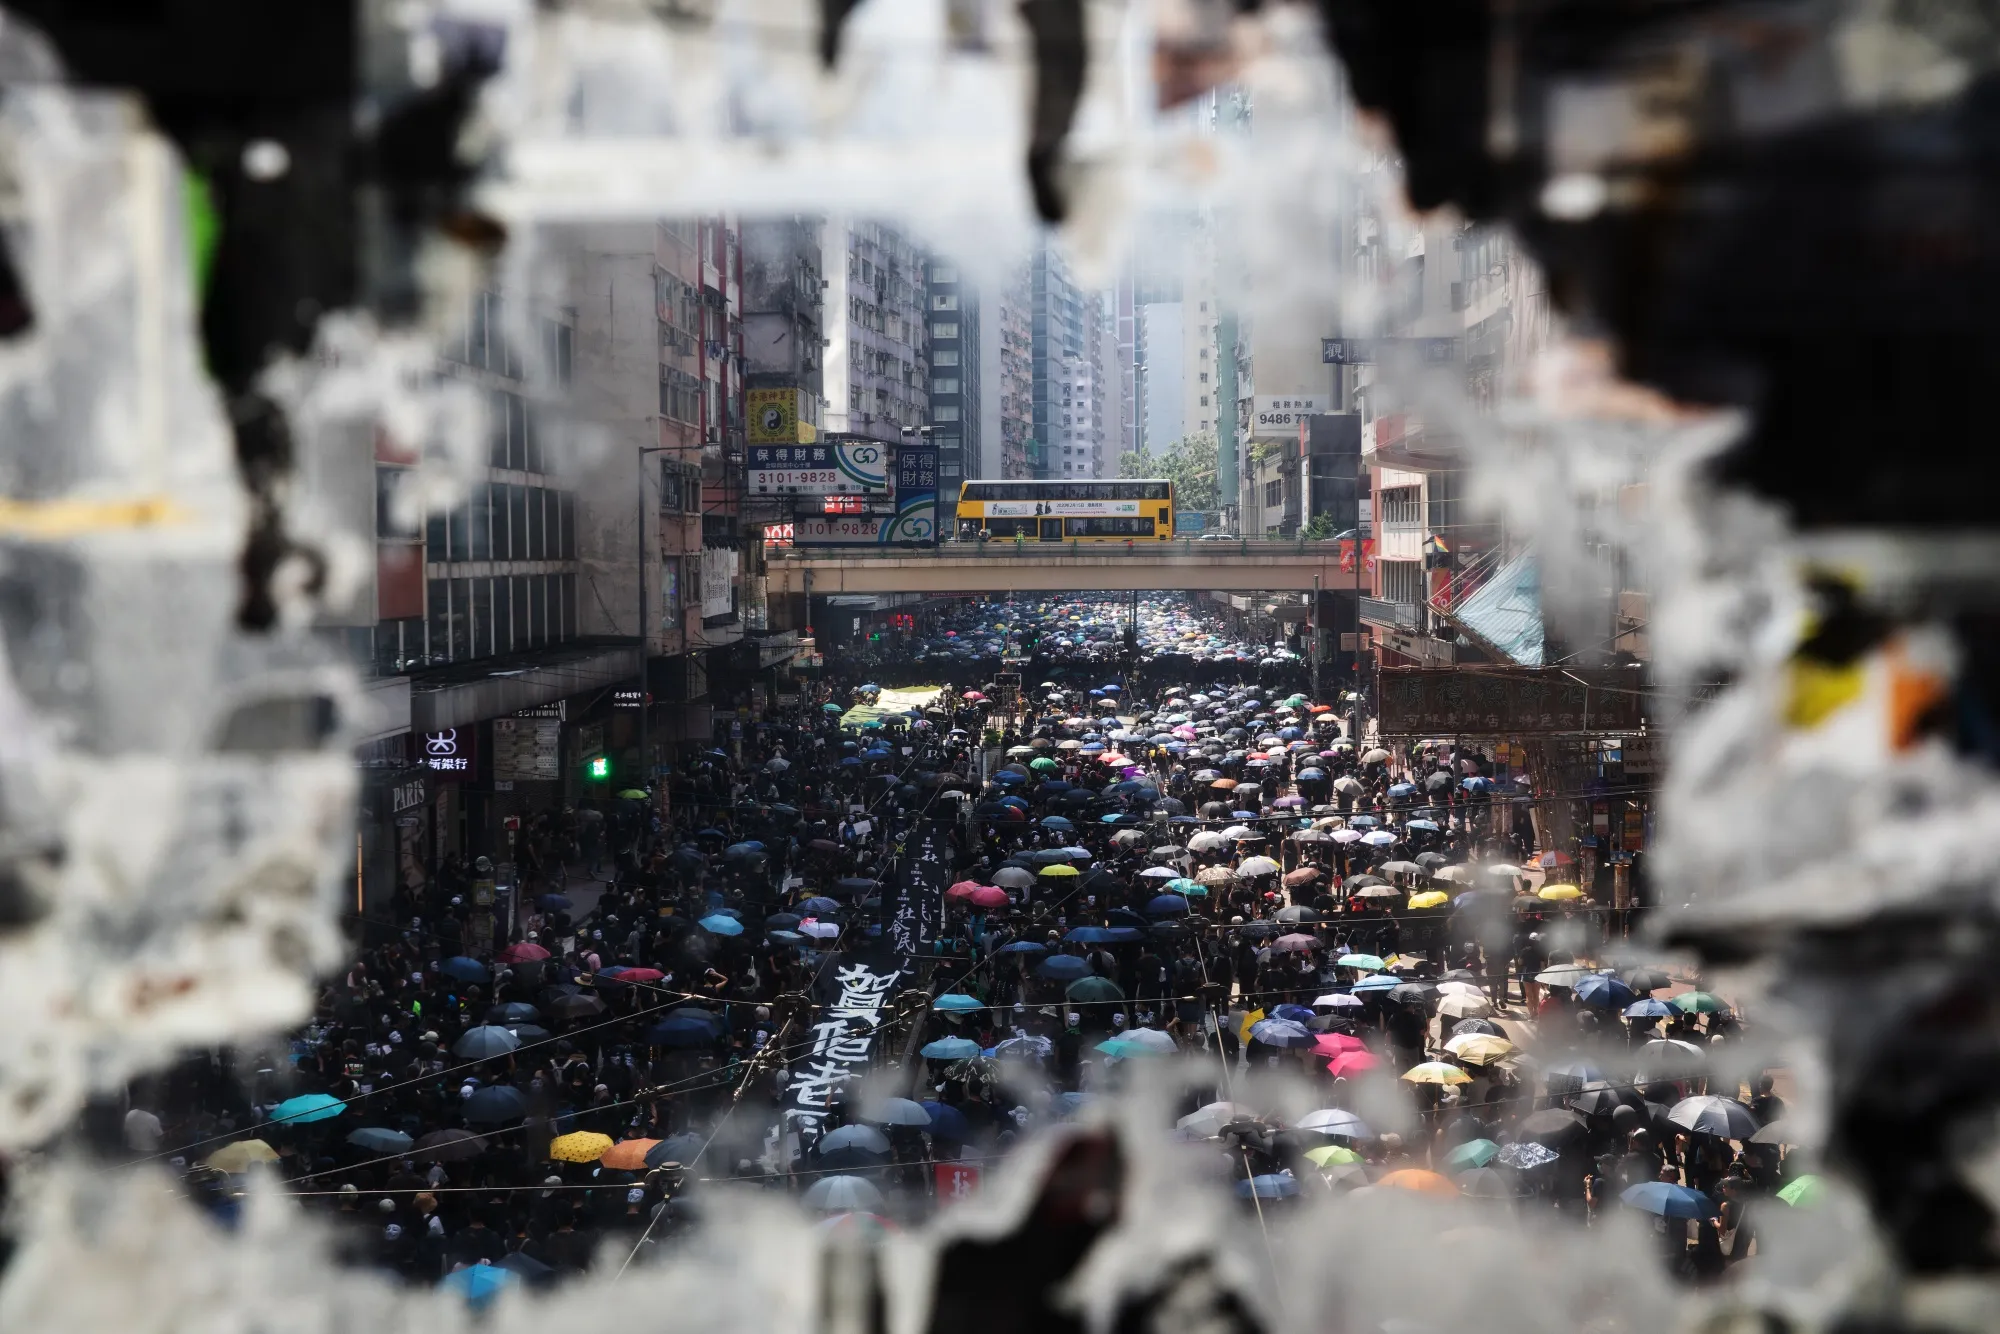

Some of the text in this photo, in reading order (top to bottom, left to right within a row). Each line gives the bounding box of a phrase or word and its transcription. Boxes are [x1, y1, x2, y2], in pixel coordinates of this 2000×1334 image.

[1260, 413, 1291, 425] 9486
[756, 448, 826, 461] 保得財務
[902, 453, 934, 468] 保得
[758, 472, 836, 484] 3101-9828
[902, 470, 934, 486] 財務
[797, 523, 878, 535] 3101-9828
[417, 758, 468, 770] 新銀行
[393, 778, 425, 813] PARIS
